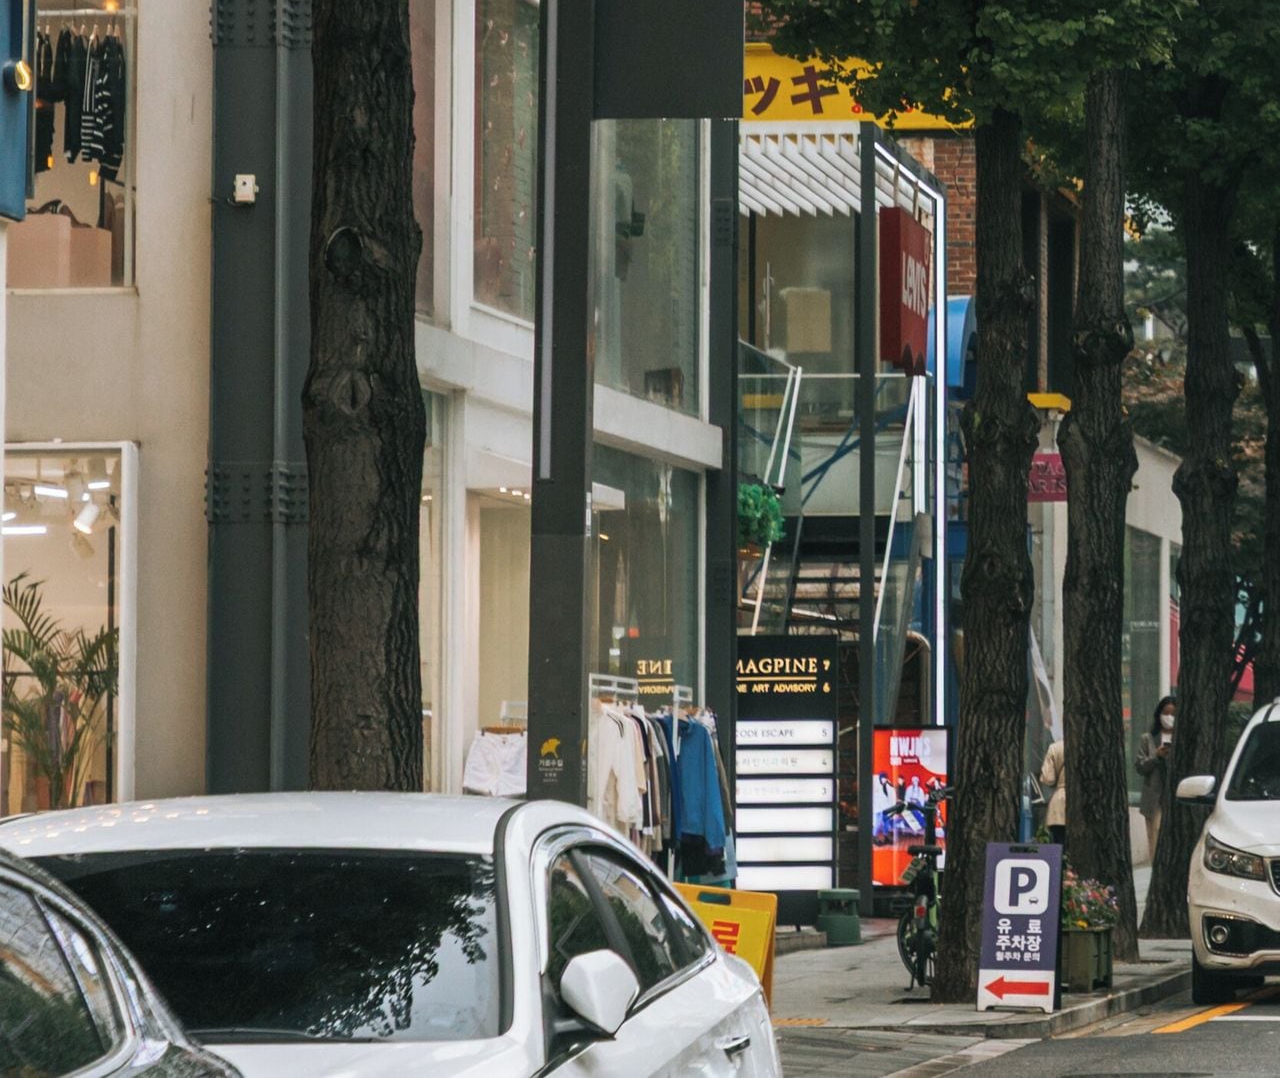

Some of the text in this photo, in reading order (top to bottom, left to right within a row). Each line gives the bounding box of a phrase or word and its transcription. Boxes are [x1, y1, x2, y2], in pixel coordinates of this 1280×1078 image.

[752, 683, 770, 693] ART
[773, 683, 817, 693] ADVISORY
[1008, 866, 1038, 907] P
[995, 935, 1042, 952] 주차장
